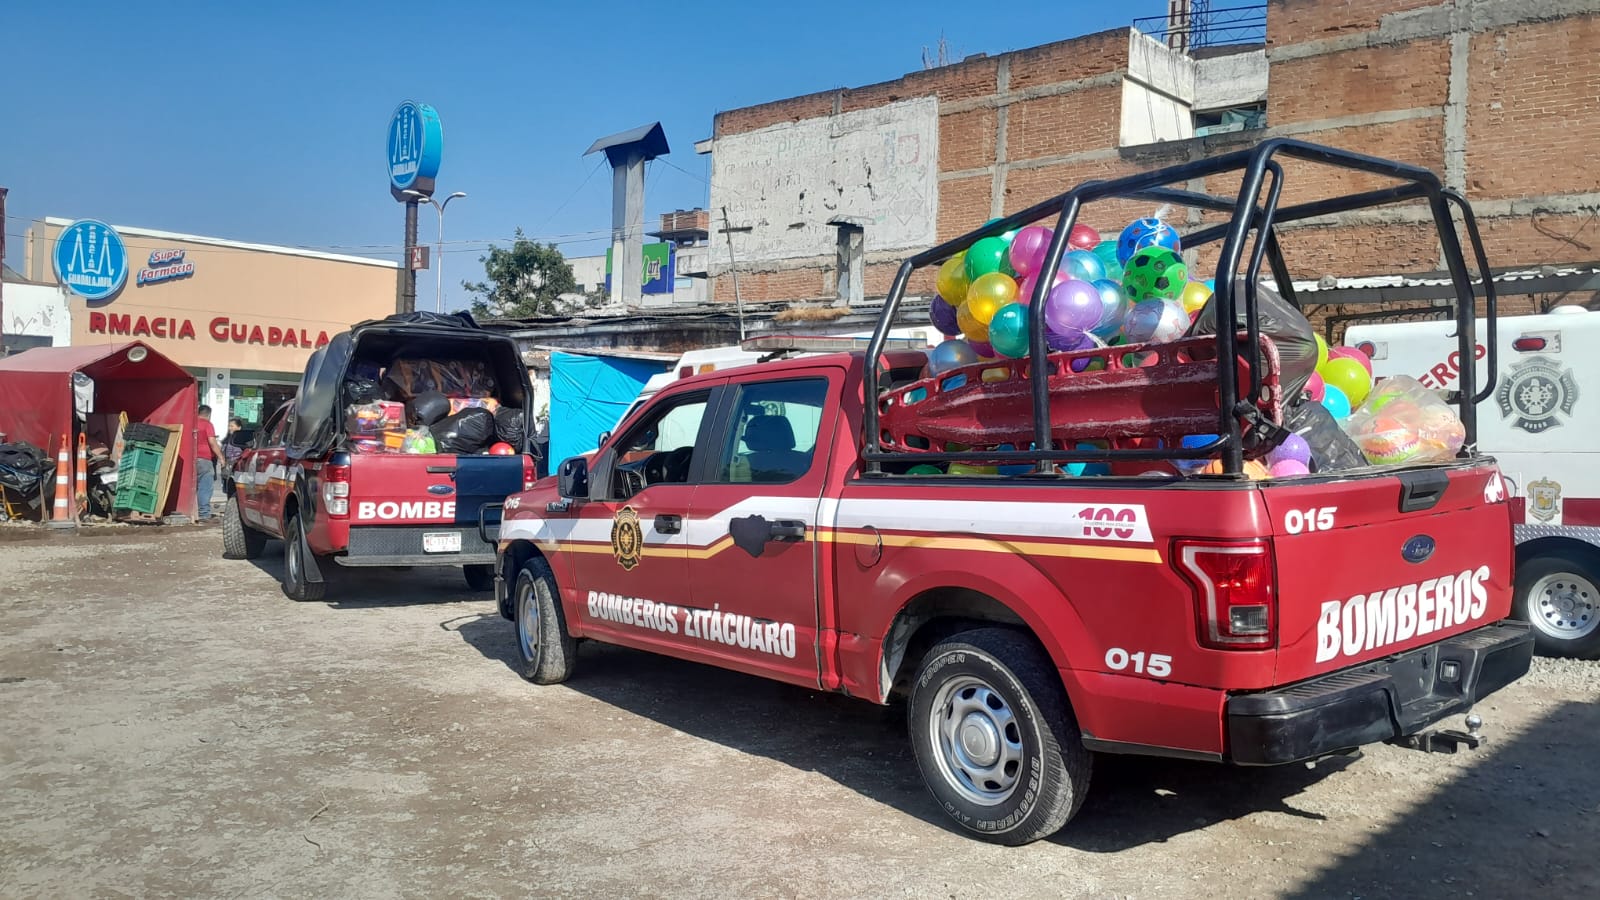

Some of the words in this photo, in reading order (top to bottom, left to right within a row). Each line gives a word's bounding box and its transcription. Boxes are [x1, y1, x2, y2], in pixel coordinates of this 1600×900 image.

[153, 249, 184, 262] Super
[140, 263, 194, 280] Farmacia
[89, 311, 196, 340] RMACIA
[358, 501, 456, 520] BOMBE
[1078, 507, 1137, 539] 100
[1284, 505, 1338, 535] 015
[587, 590, 679, 634] BOMBEROS
[684, 602, 796, 659] ZITÁCUARO
[1315, 565, 1490, 663] BOMBEROS
[1104, 647, 1172, 677] 015
